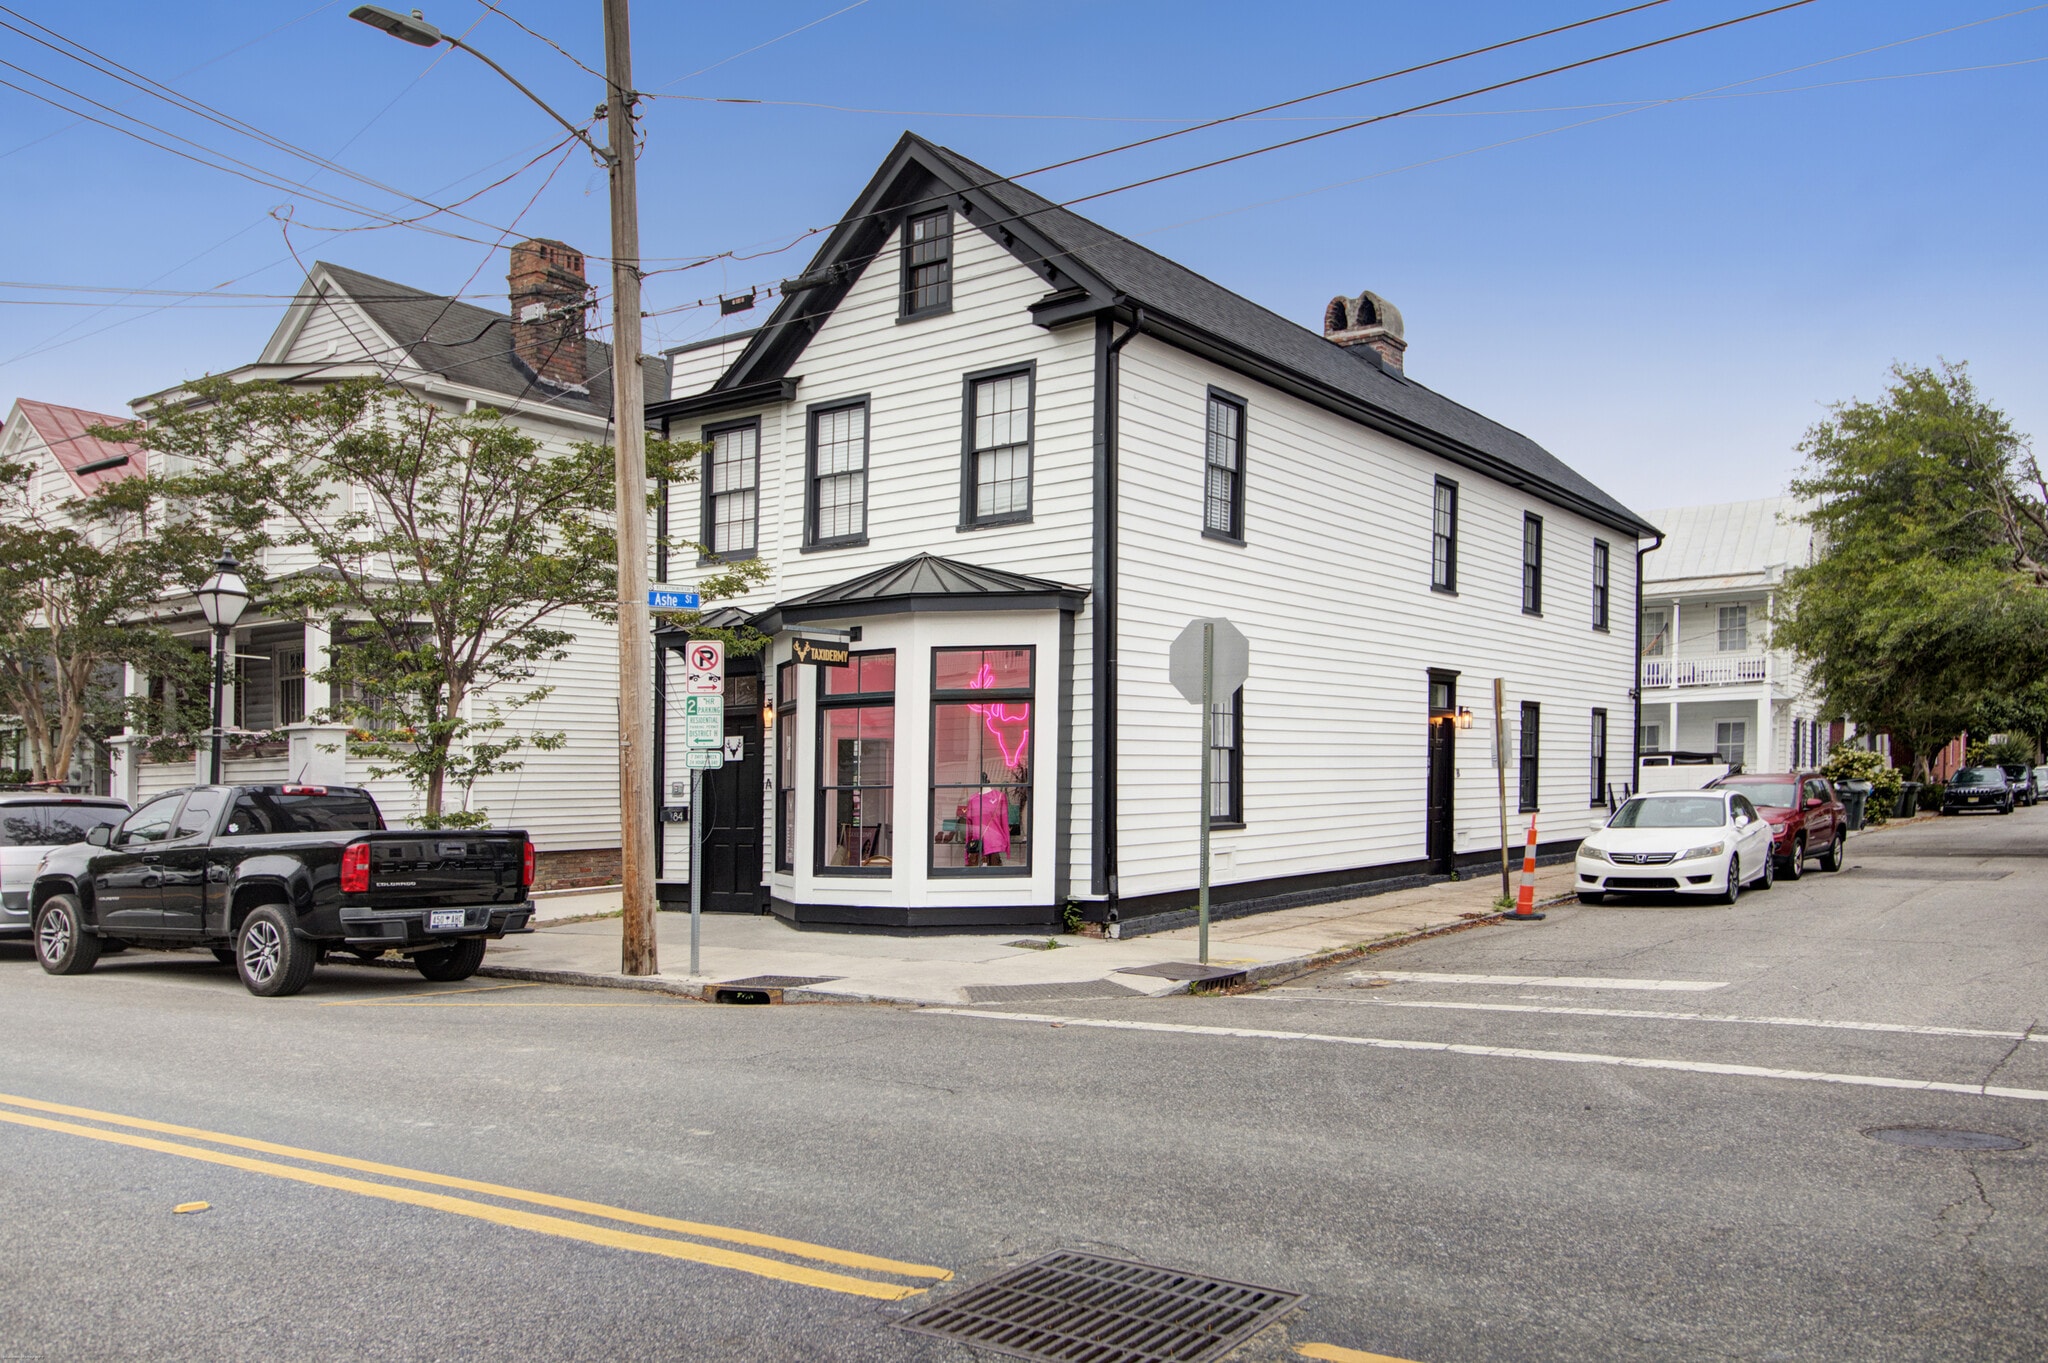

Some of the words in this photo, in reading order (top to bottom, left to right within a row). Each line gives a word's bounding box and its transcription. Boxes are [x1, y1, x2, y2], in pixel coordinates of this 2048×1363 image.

[655, 593, 678, 606] Ashe
[685, 594, 692, 604] St
[811, 647, 848, 662] TAXIDERMY
[687, 700, 696, 713] 2
[698, 706, 720, 714] PARKING
[765, 778, 772, 790] A
